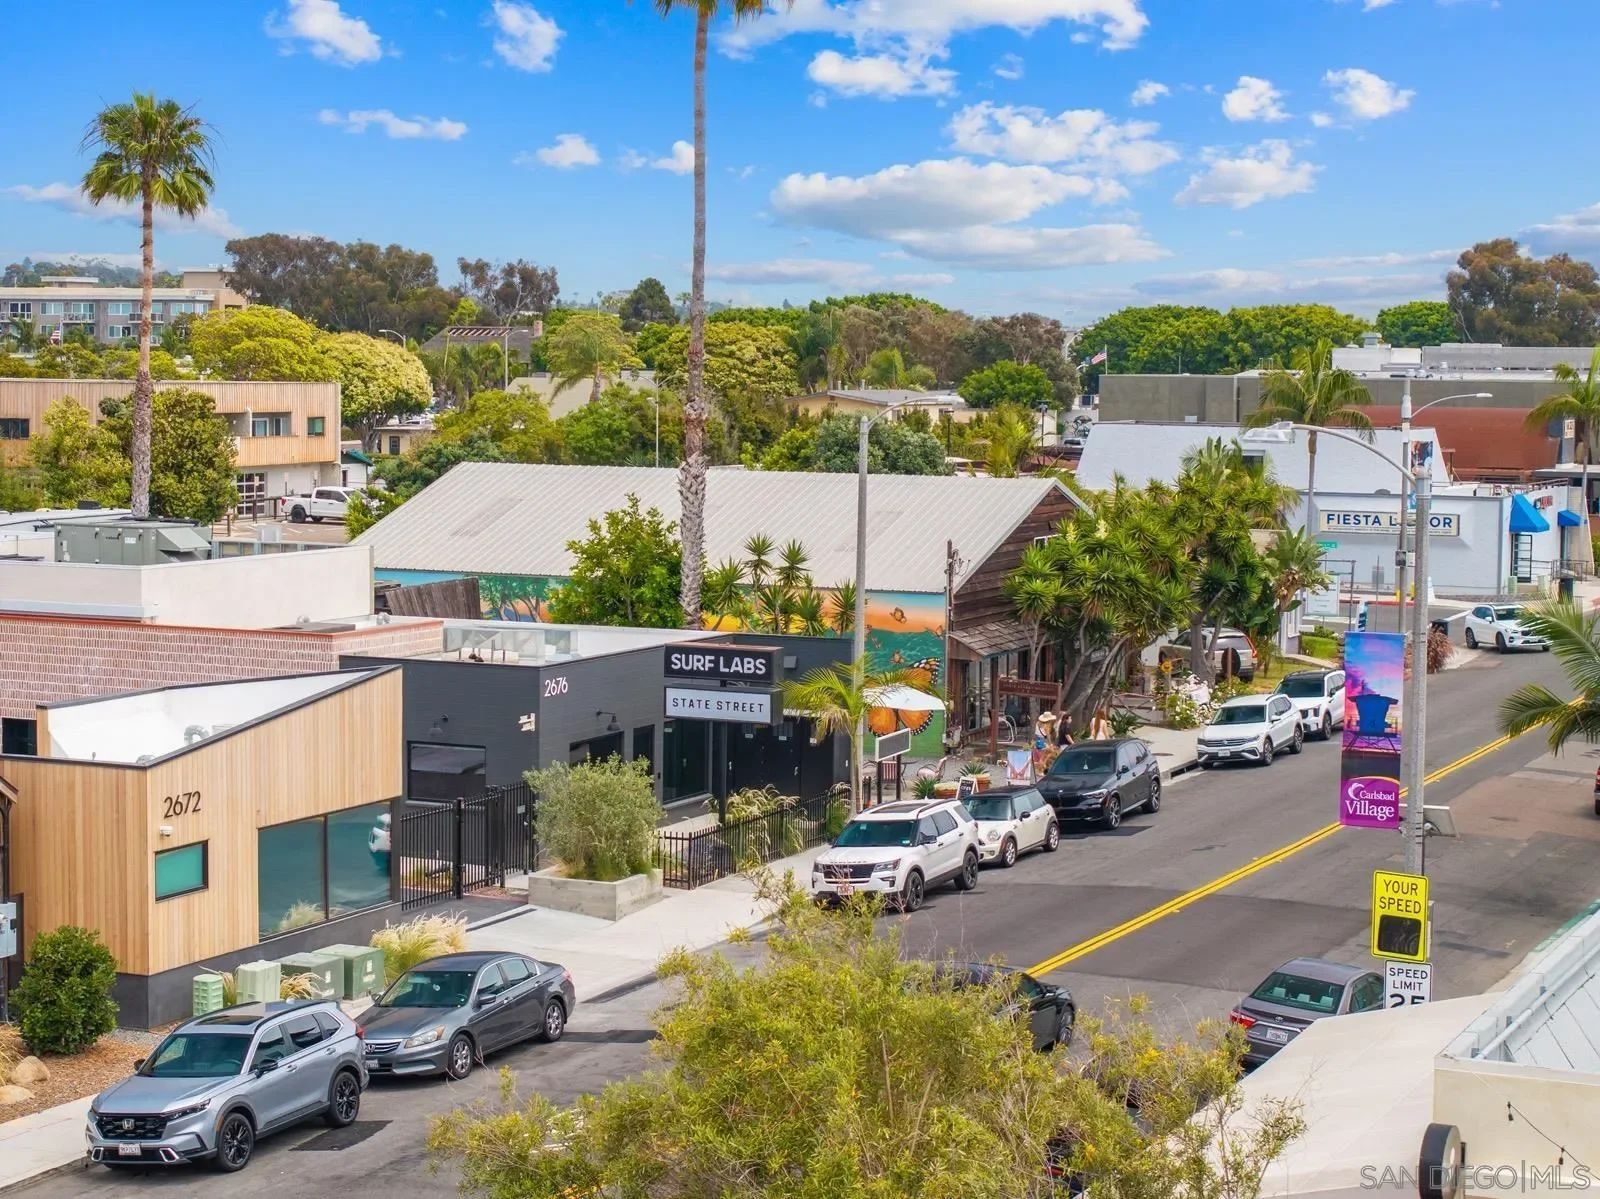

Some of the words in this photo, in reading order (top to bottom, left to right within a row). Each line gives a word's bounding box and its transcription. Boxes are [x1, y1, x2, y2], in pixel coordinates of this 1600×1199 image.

[1326, 513, 1382, 526] FIESTA
[1389, 515, 1452, 528] LOR
[670, 653, 715, 671] SURF
[719, 655, 766, 675] LABS
[544, 676, 568, 697] 2676
[672, 698, 710, 710] STATE
[716, 700, 764, 713] STREET
[1359, 789, 1395, 801] Carlsbad
[163, 791, 201, 819] 2672
[1345, 800, 1395, 822] Village
[1383, 879, 1418, 896] YOUR
[1379, 896, 1422, 914] SPEED
[1389, 966, 1428, 980] SPEED
[1392, 979, 1423, 991] LIMIT
